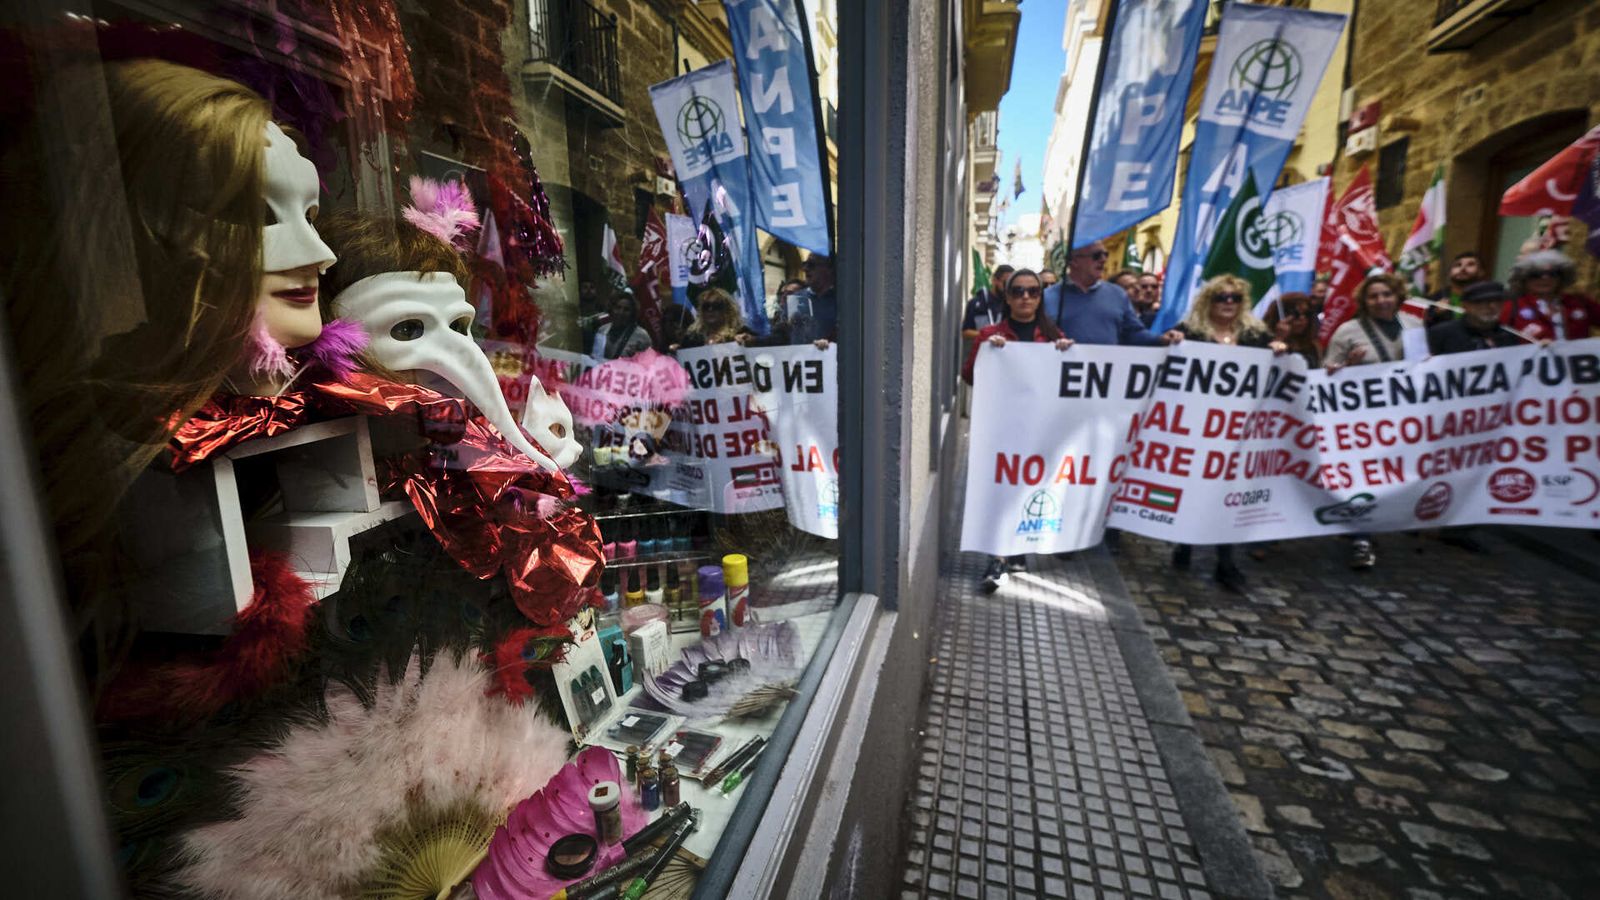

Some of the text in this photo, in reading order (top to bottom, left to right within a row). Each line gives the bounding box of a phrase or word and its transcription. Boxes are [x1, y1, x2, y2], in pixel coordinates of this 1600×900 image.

[1215, 89, 1292, 124] ANPE
[1059, 361, 1113, 399] EN
[1124, 354, 1258, 400] DENSA
[1143, 401, 1190, 436] AL
[1203, 408, 1316, 450] DECRETO
[995, 452, 1045, 485] NO
[1056, 455, 1097, 485] AL
[1203, 450, 1239, 480] DE
[1362, 456, 1405, 487] EN
[1417, 436, 1549, 481] CENTROS
[1565, 435, 1600, 462] P
